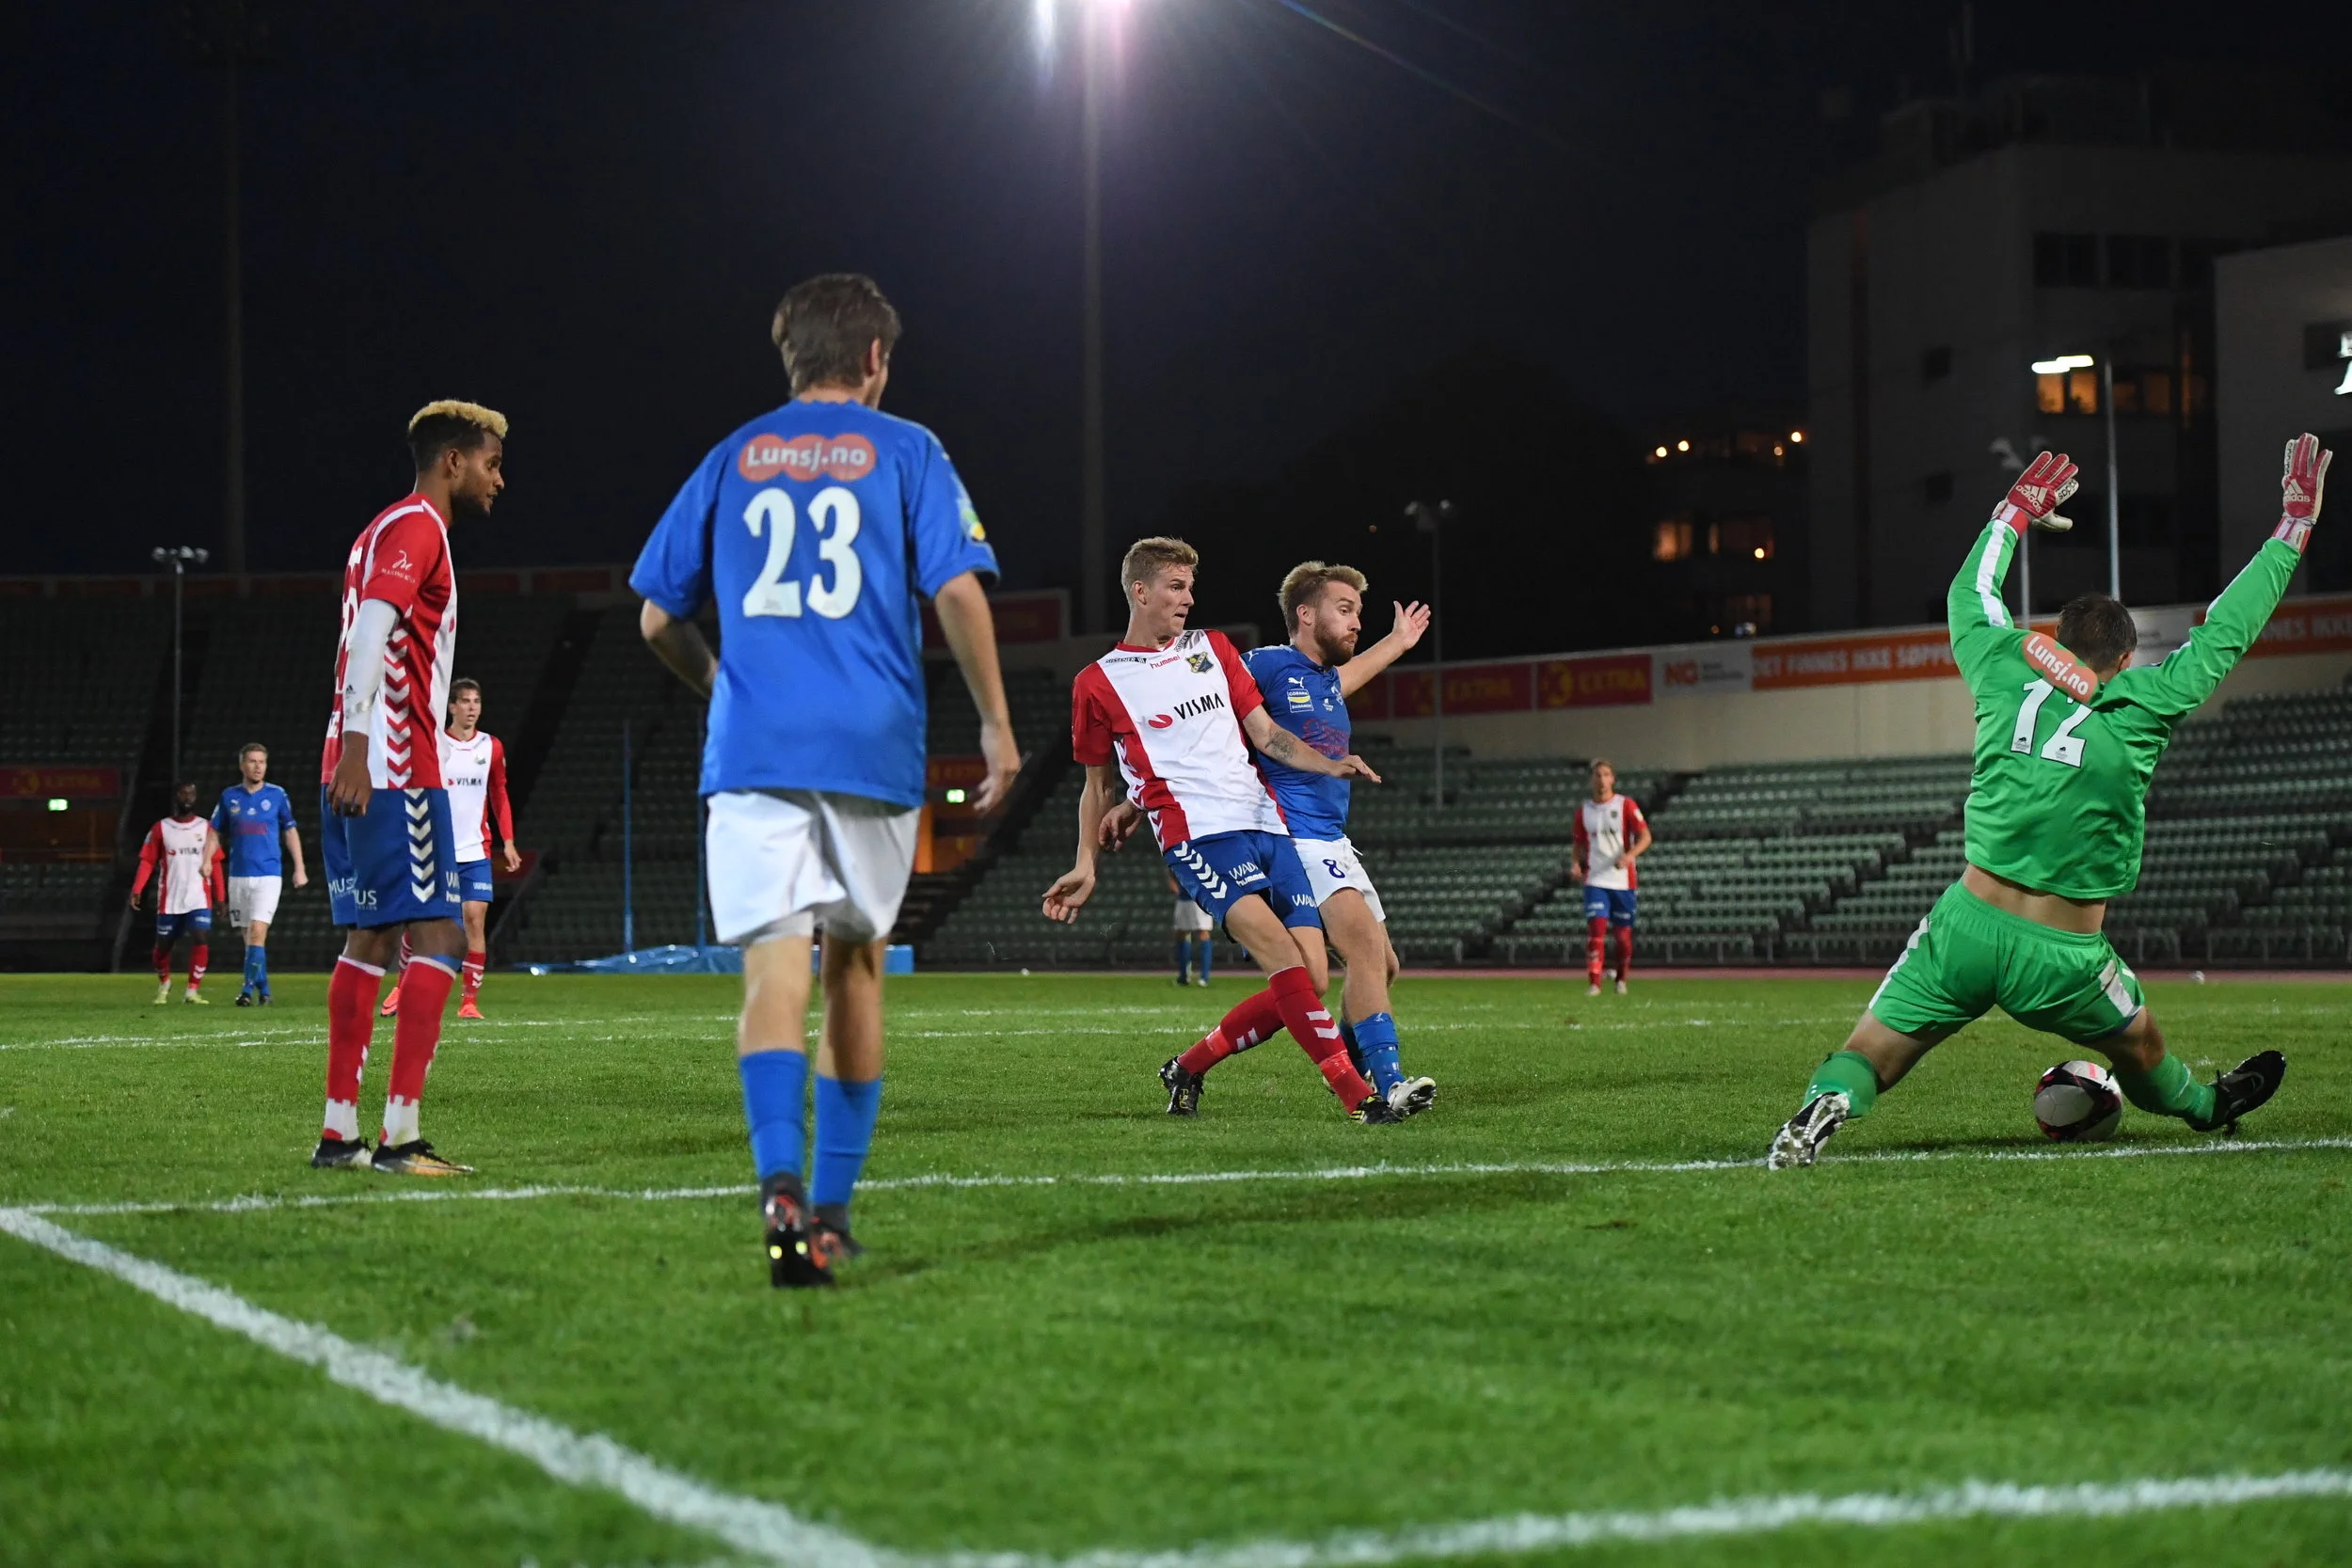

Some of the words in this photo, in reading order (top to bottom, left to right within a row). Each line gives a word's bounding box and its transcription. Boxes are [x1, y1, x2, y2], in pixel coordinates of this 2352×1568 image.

[747, 442, 867, 472] Lunsj.no
[2015, 484, 2042, 514] adidas
[742, 486, 862, 619] 23
[1150, 655, 1181, 669] hummel
[2026, 635, 2090, 696] Lunsj.no
[1579, 669, 1645, 695] EXTRA
[1173, 691, 1225, 721] VISMA
[2010, 678, 2093, 768] 12
[456, 777, 482, 786] VISMA
[1235, 871, 1266, 887] hummel
[1322, 858, 1346, 879] 8
